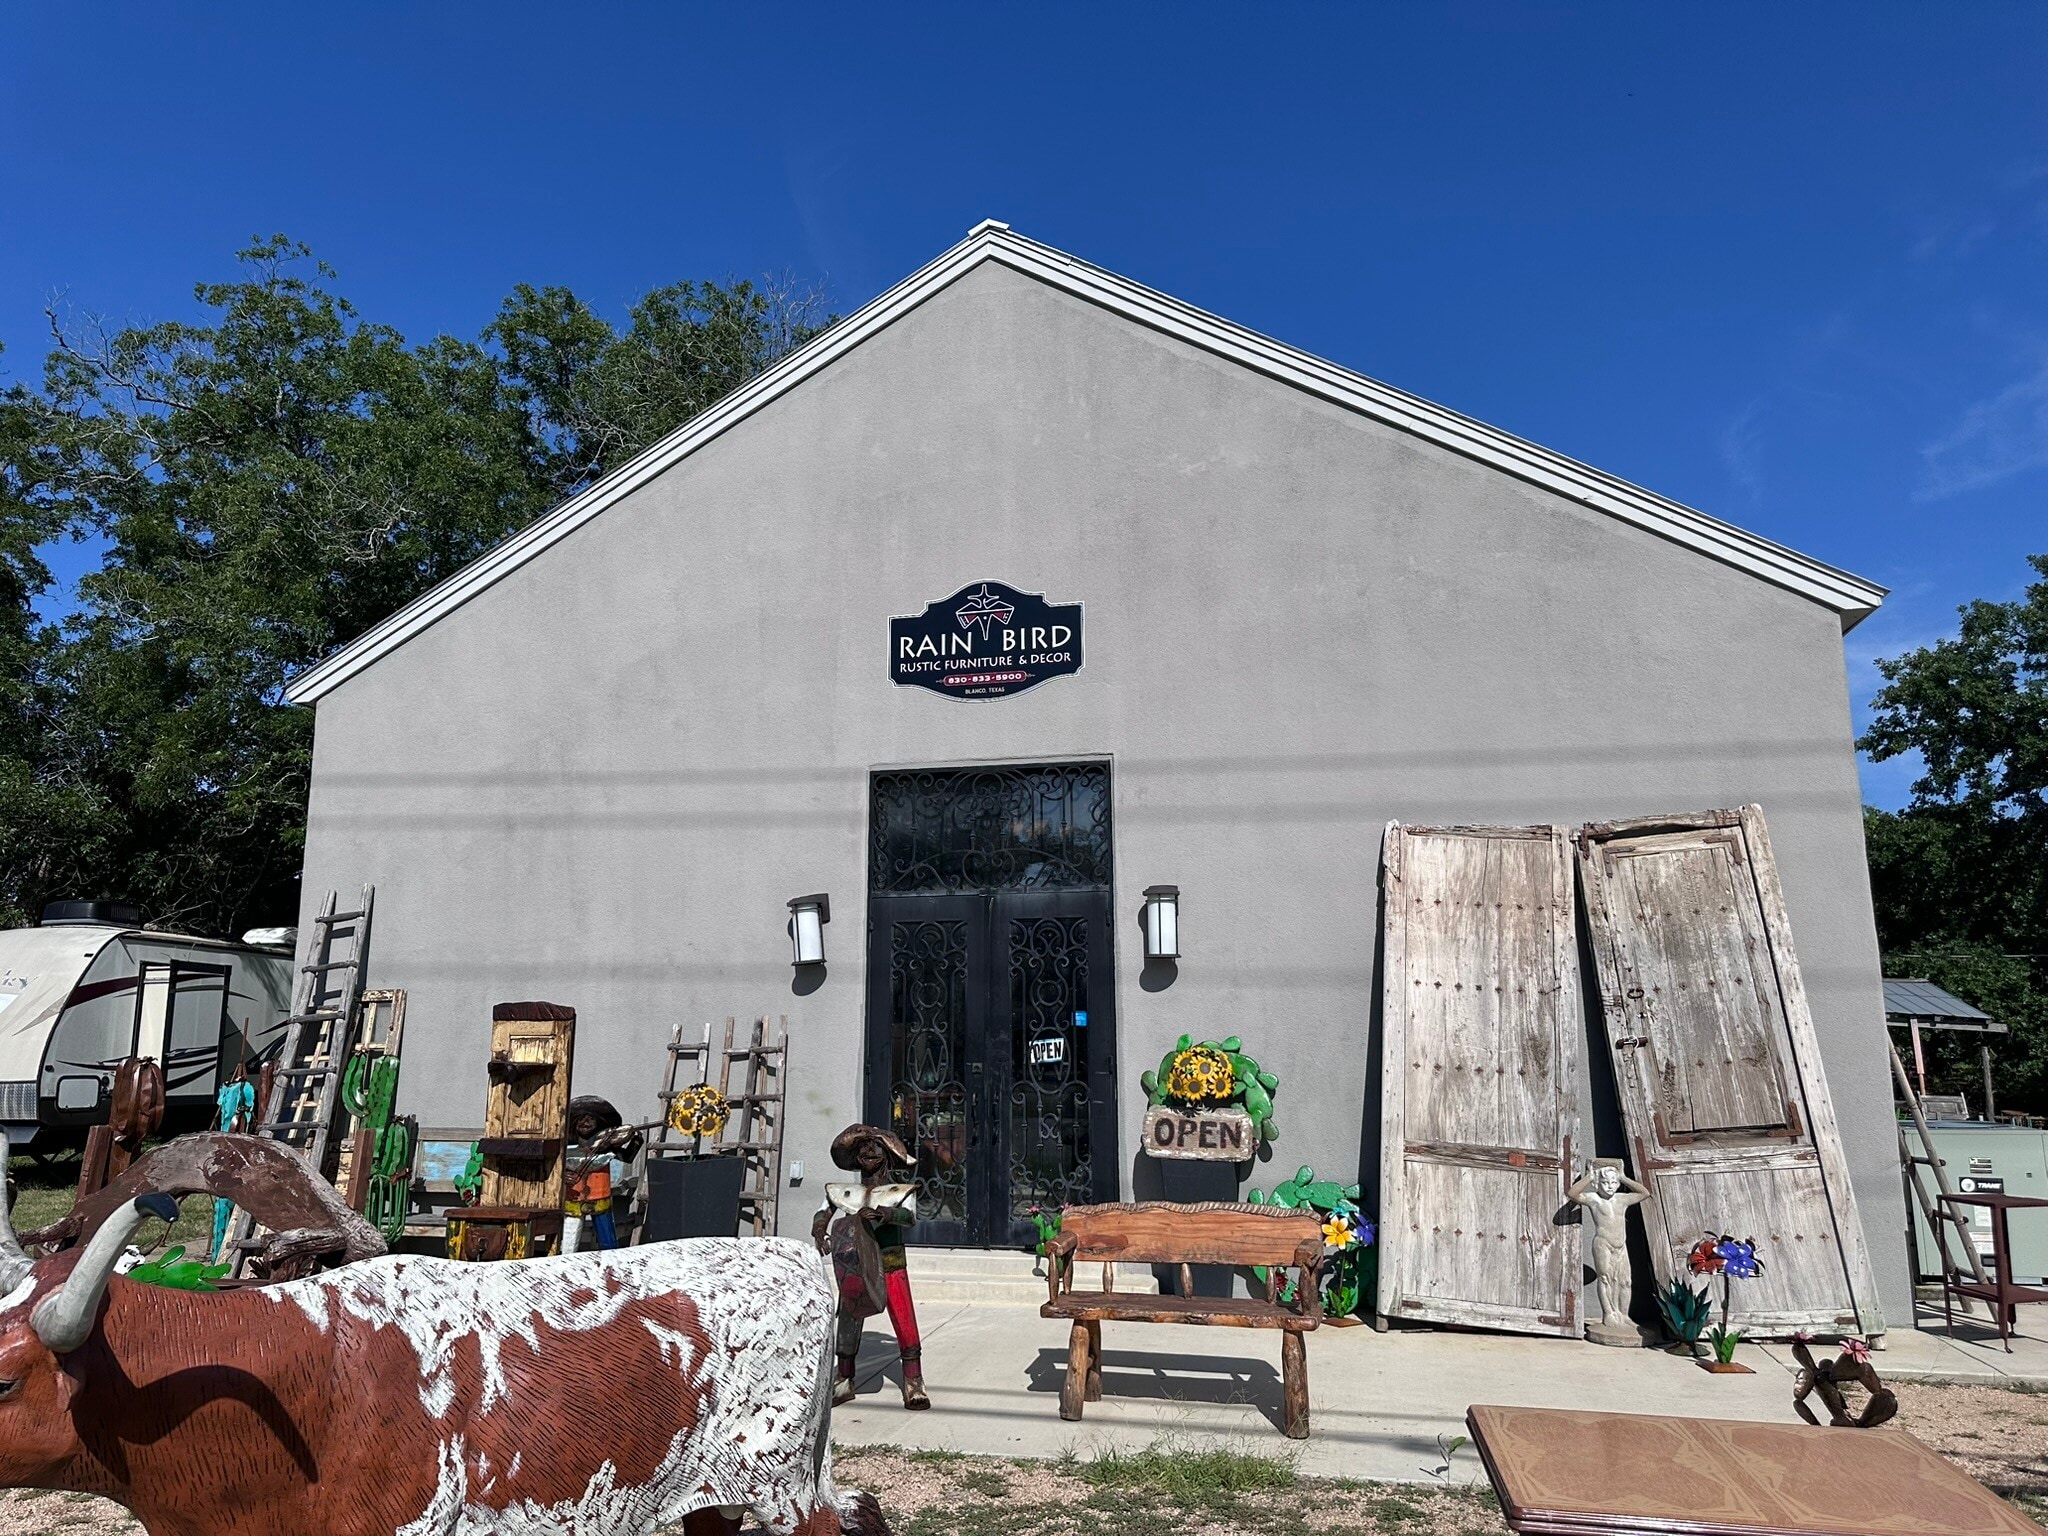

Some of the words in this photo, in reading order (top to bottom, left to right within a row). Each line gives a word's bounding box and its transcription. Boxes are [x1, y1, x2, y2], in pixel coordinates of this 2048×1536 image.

[900, 631, 972, 658] RAIN
[1003, 625, 1071, 651] BIRD
[900, 661, 941, 673] RUSTIC
[945, 655, 1012, 669] FURNITURE
[1018, 654, 1027, 664] &
[1031, 652, 1071, 664] DECOR
[1032, 1041, 1062, 1061] OPEN
[1154, 1117, 1242, 1149] OPEN
